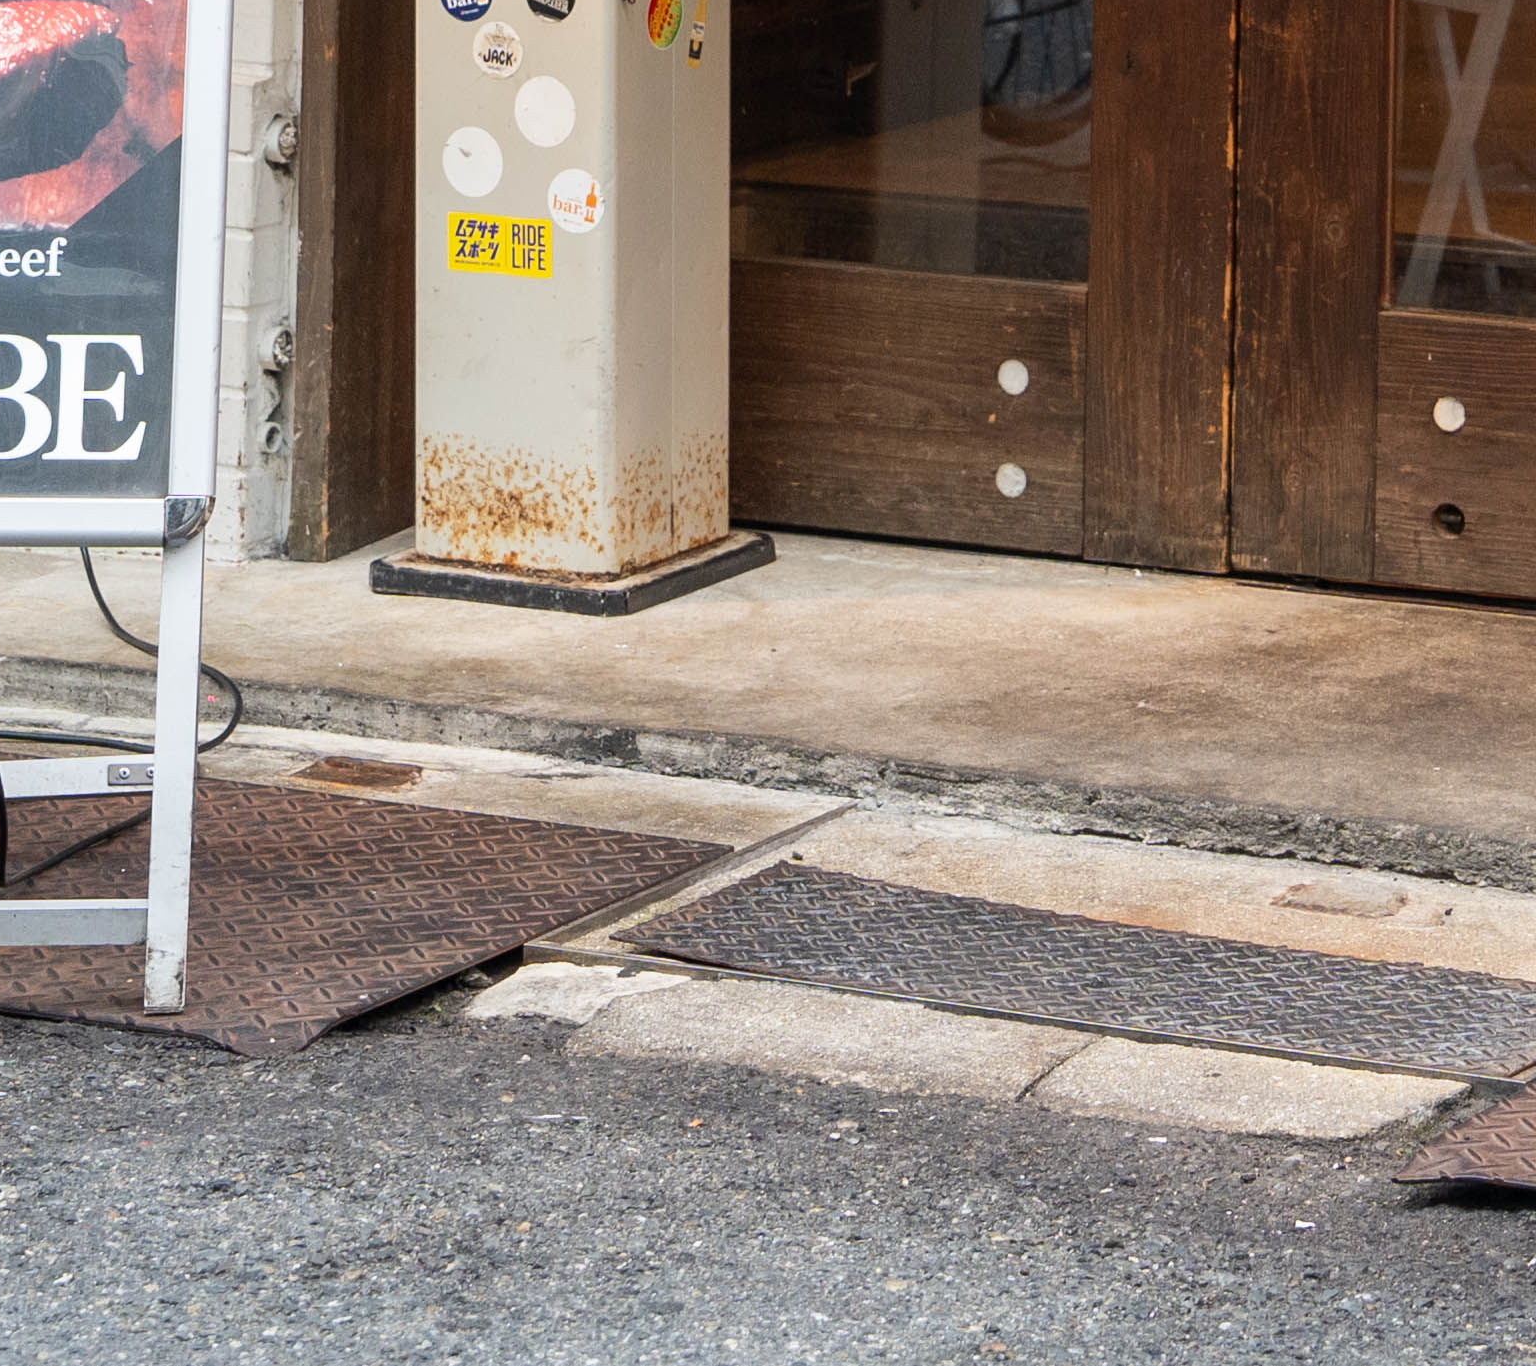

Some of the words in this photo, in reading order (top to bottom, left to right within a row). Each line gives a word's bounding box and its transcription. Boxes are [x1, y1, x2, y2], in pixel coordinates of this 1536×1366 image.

[483, 48, 514, 67] JACK
[455, 219, 499, 239] ムラサキ
[512, 224, 546, 247] RIDE
[455, 239, 500, 260] スポーツ
[512, 247, 546, 271] LIFE
